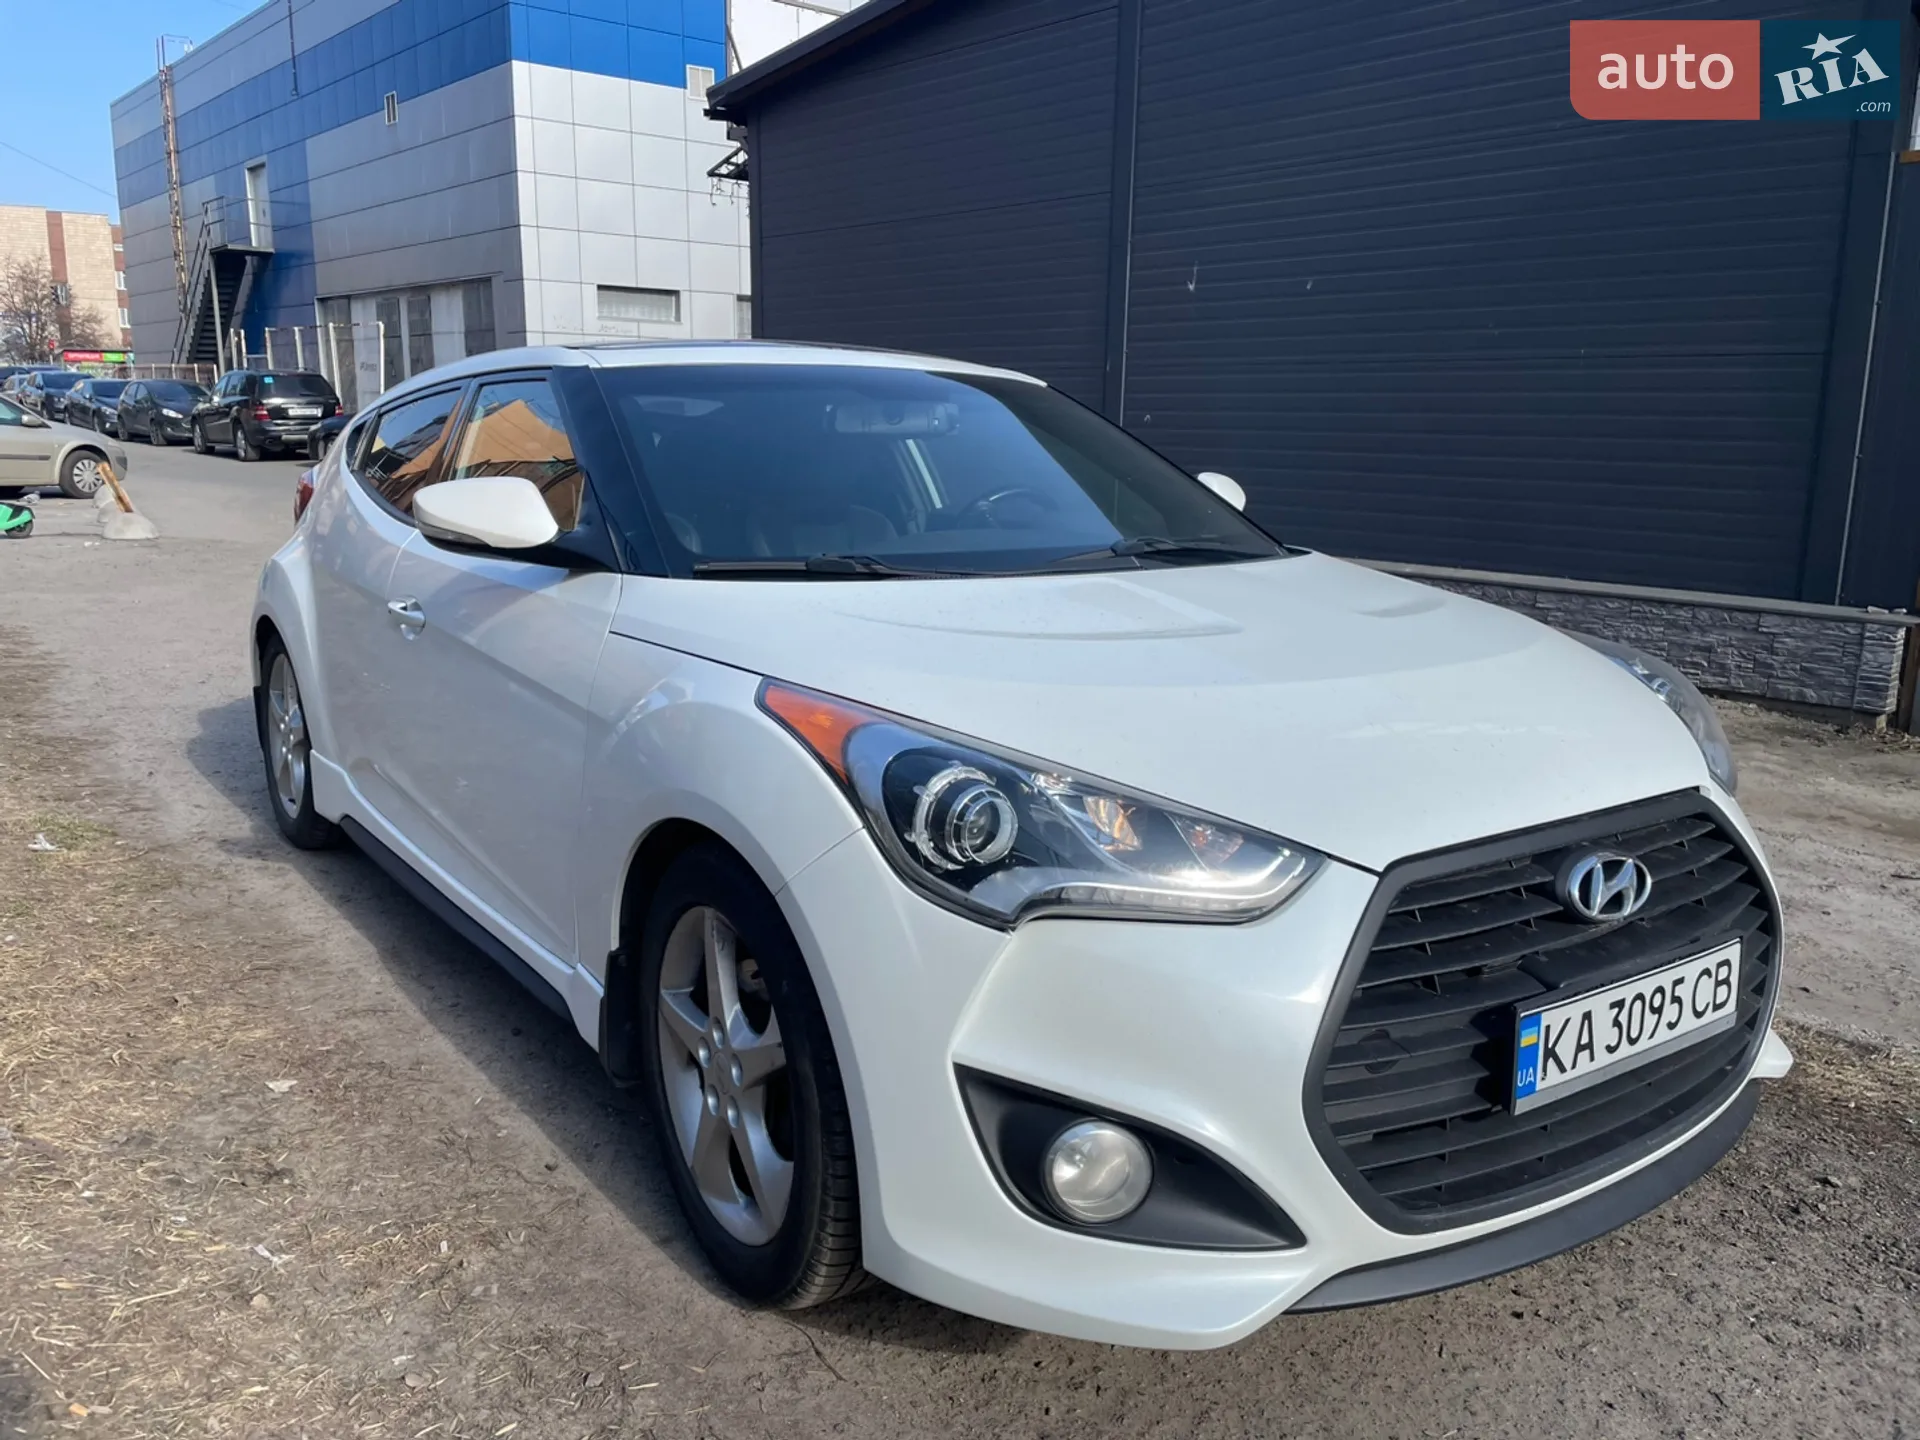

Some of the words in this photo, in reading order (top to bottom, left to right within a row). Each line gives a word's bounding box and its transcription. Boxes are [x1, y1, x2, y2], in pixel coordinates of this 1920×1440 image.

[1541, 1009, 1595, 1081] KA
[1605, 976, 1685, 1054] 3095
[1691, 958, 1733, 1019] CB
[1517, 1069, 1535, 1087] UA
